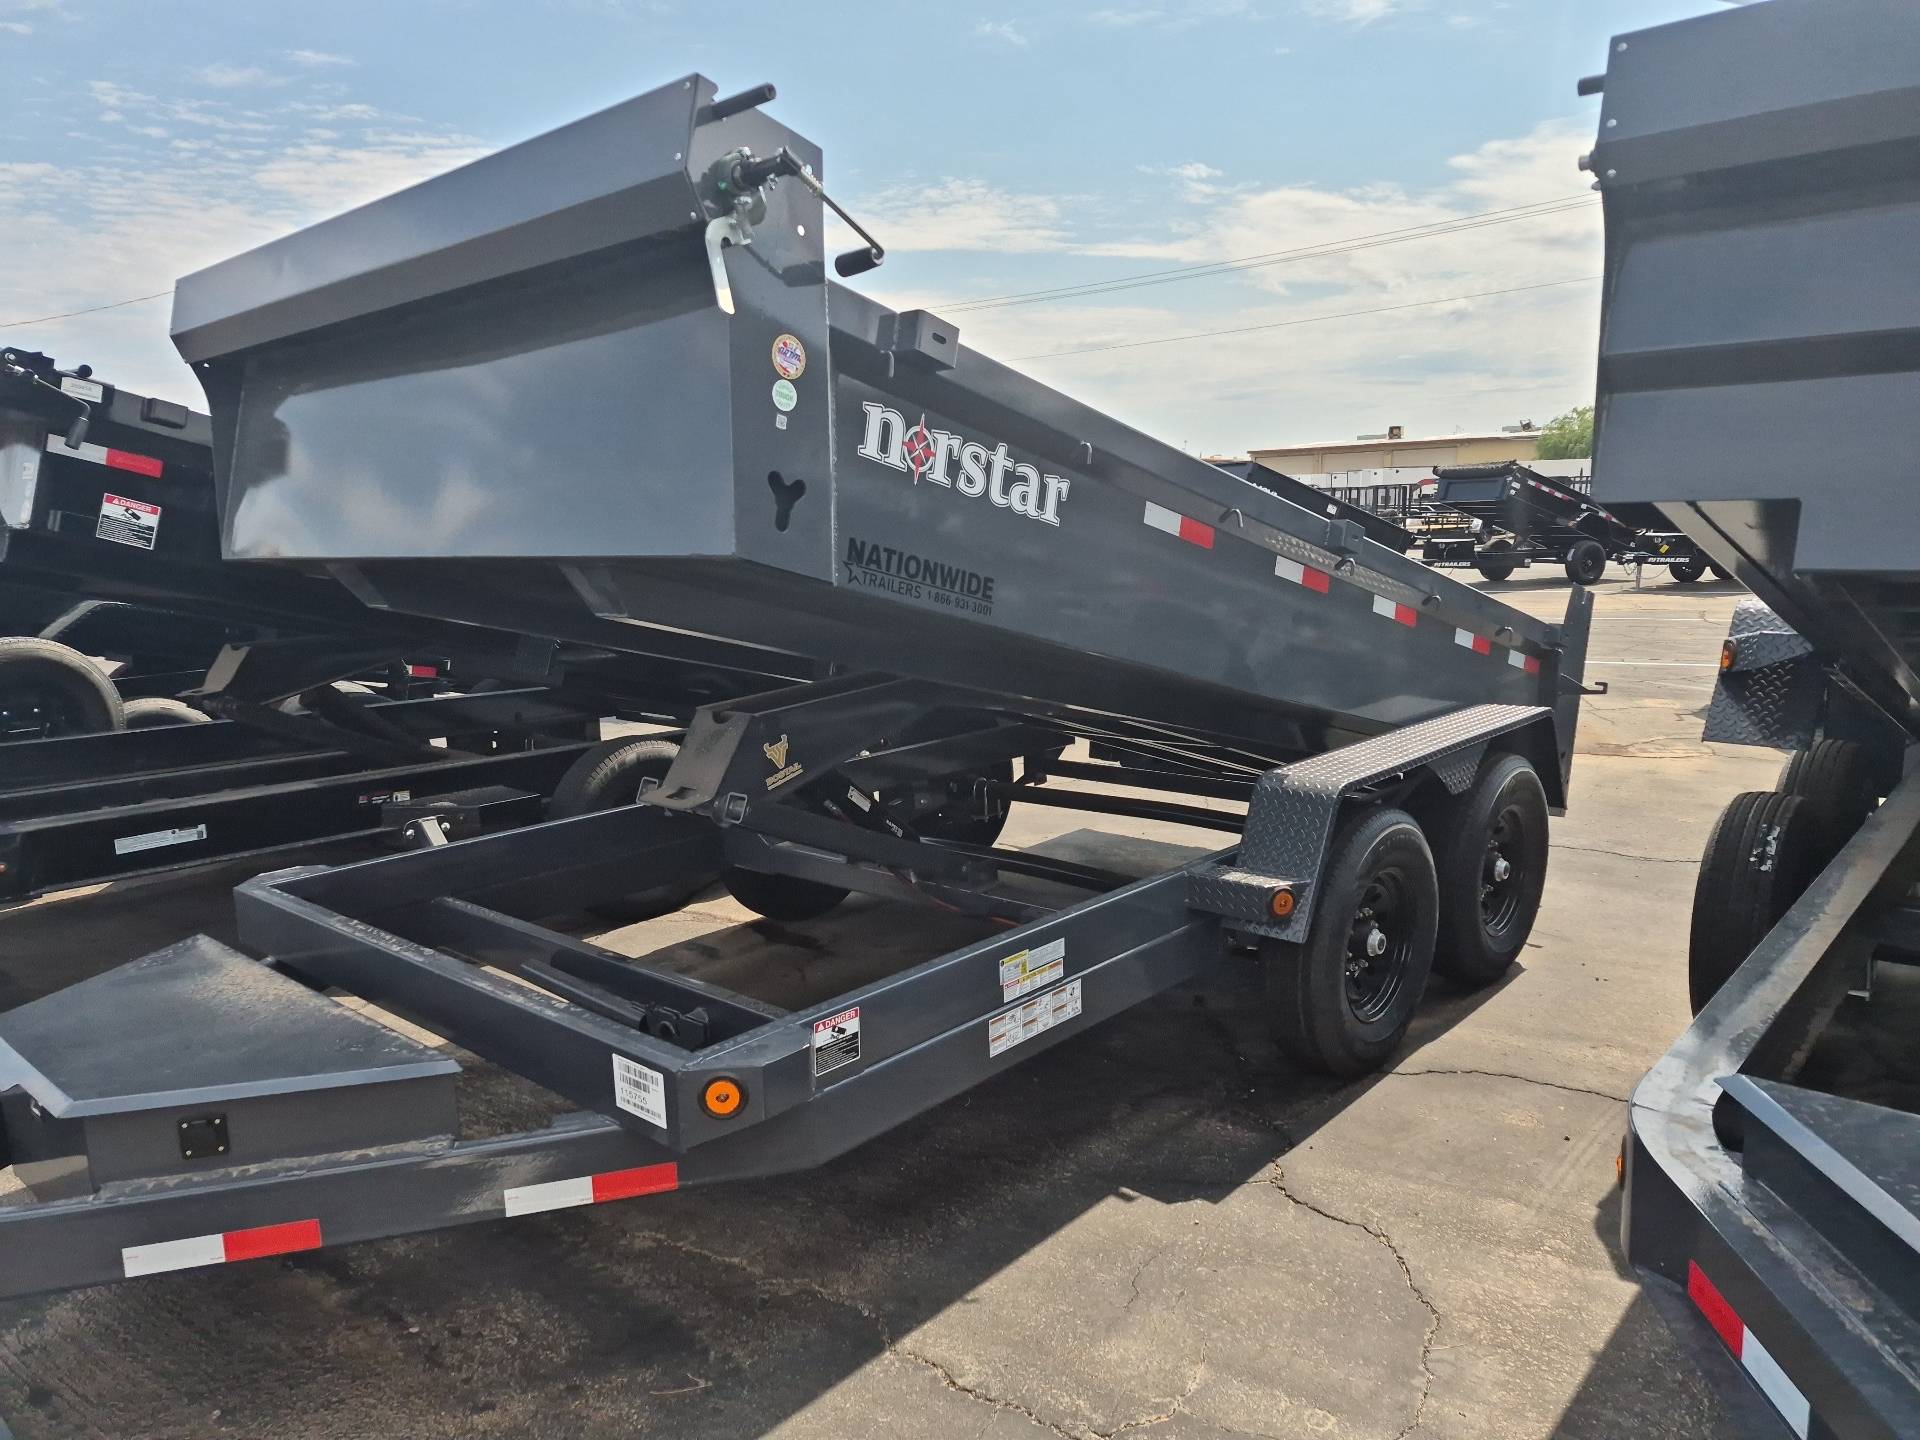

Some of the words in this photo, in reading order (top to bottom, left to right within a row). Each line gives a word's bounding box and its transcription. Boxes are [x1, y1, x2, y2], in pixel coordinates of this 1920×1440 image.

[858, 401, 1071, 527] norstar
[120, 499, 151, 513] DANGER
[847, 537, 995, 600] NATIONWIDE
[861, 570, 922, 599] TRAILERS
[825, 1010, 856, 1028] DANGER
